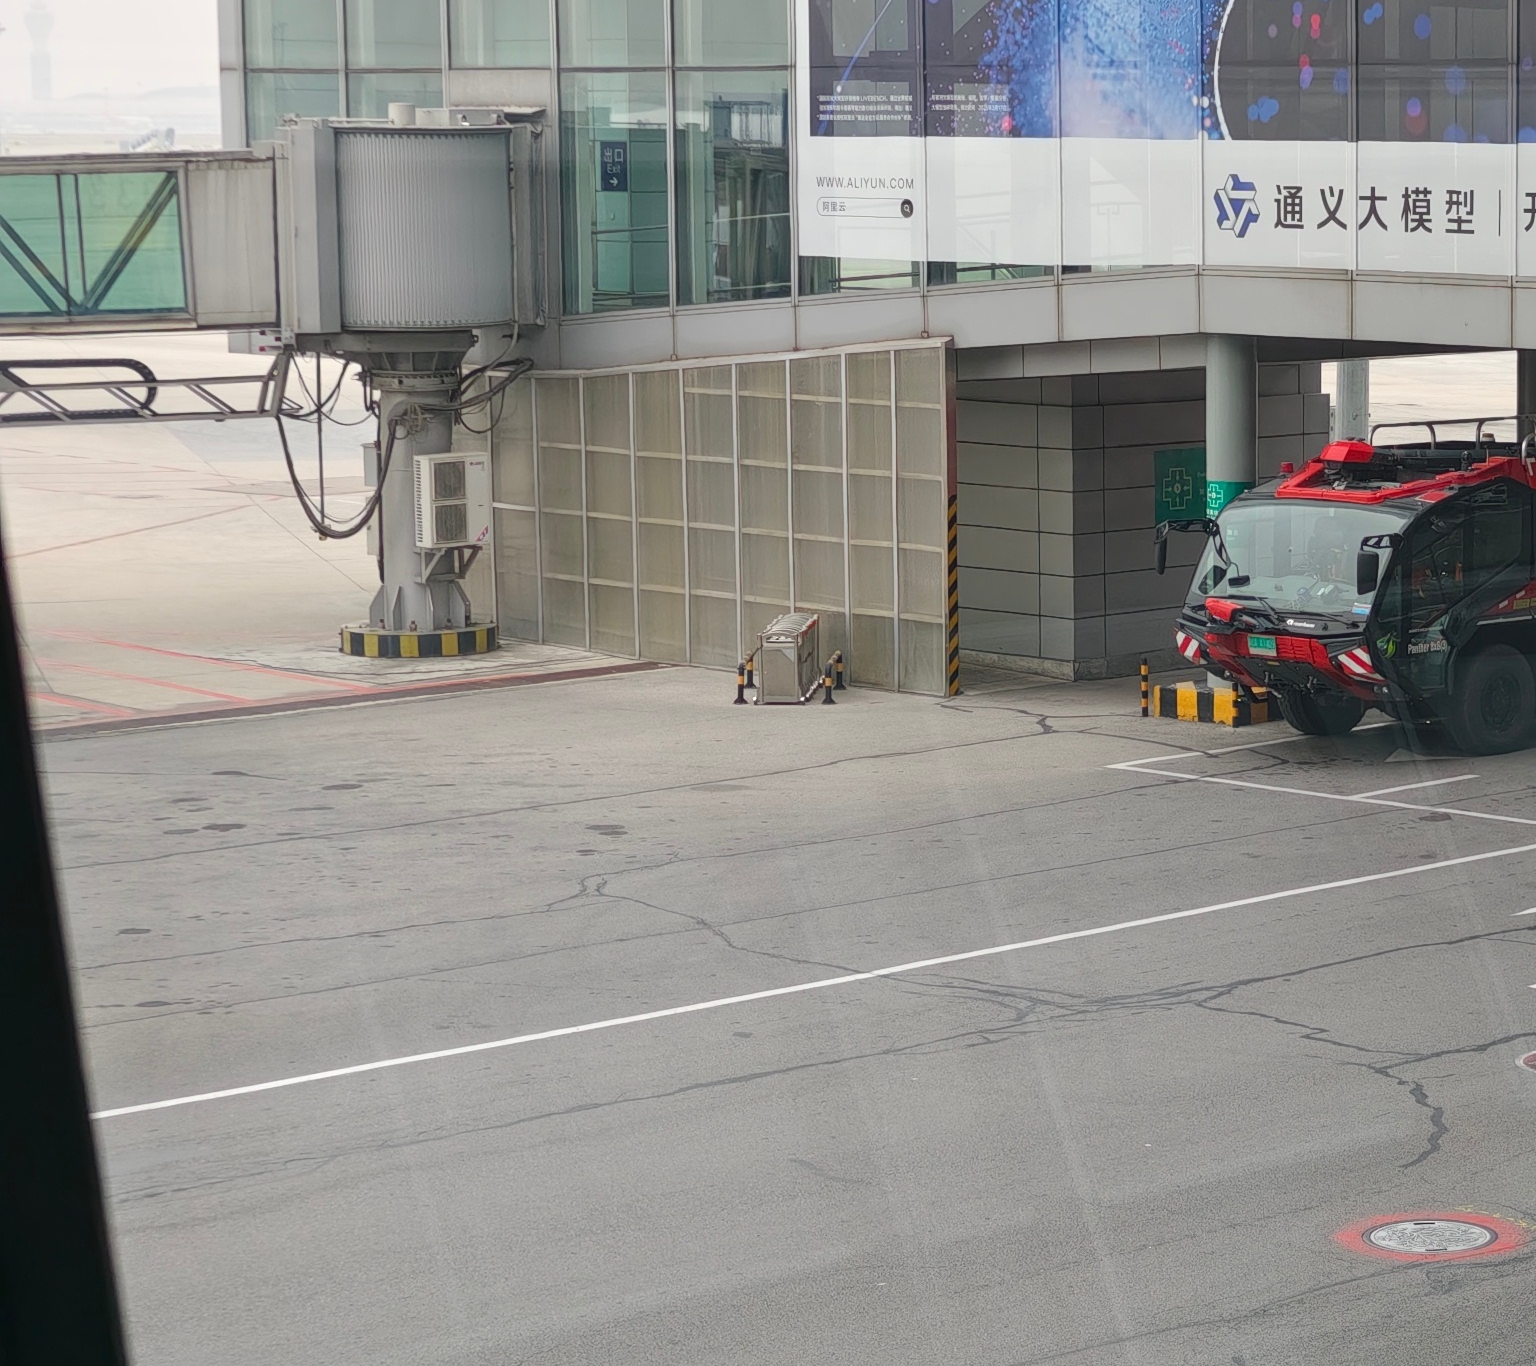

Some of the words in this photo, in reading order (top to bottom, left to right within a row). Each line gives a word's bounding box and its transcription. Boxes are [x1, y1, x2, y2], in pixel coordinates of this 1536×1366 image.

[603, 147, 624, 163] 出口
[815, 176, 914, 190] WWW.ALIYUN.COM
[822, 201, 846, 213] 阿里云
[1273, 184, 1476, 235] 通义大模型
